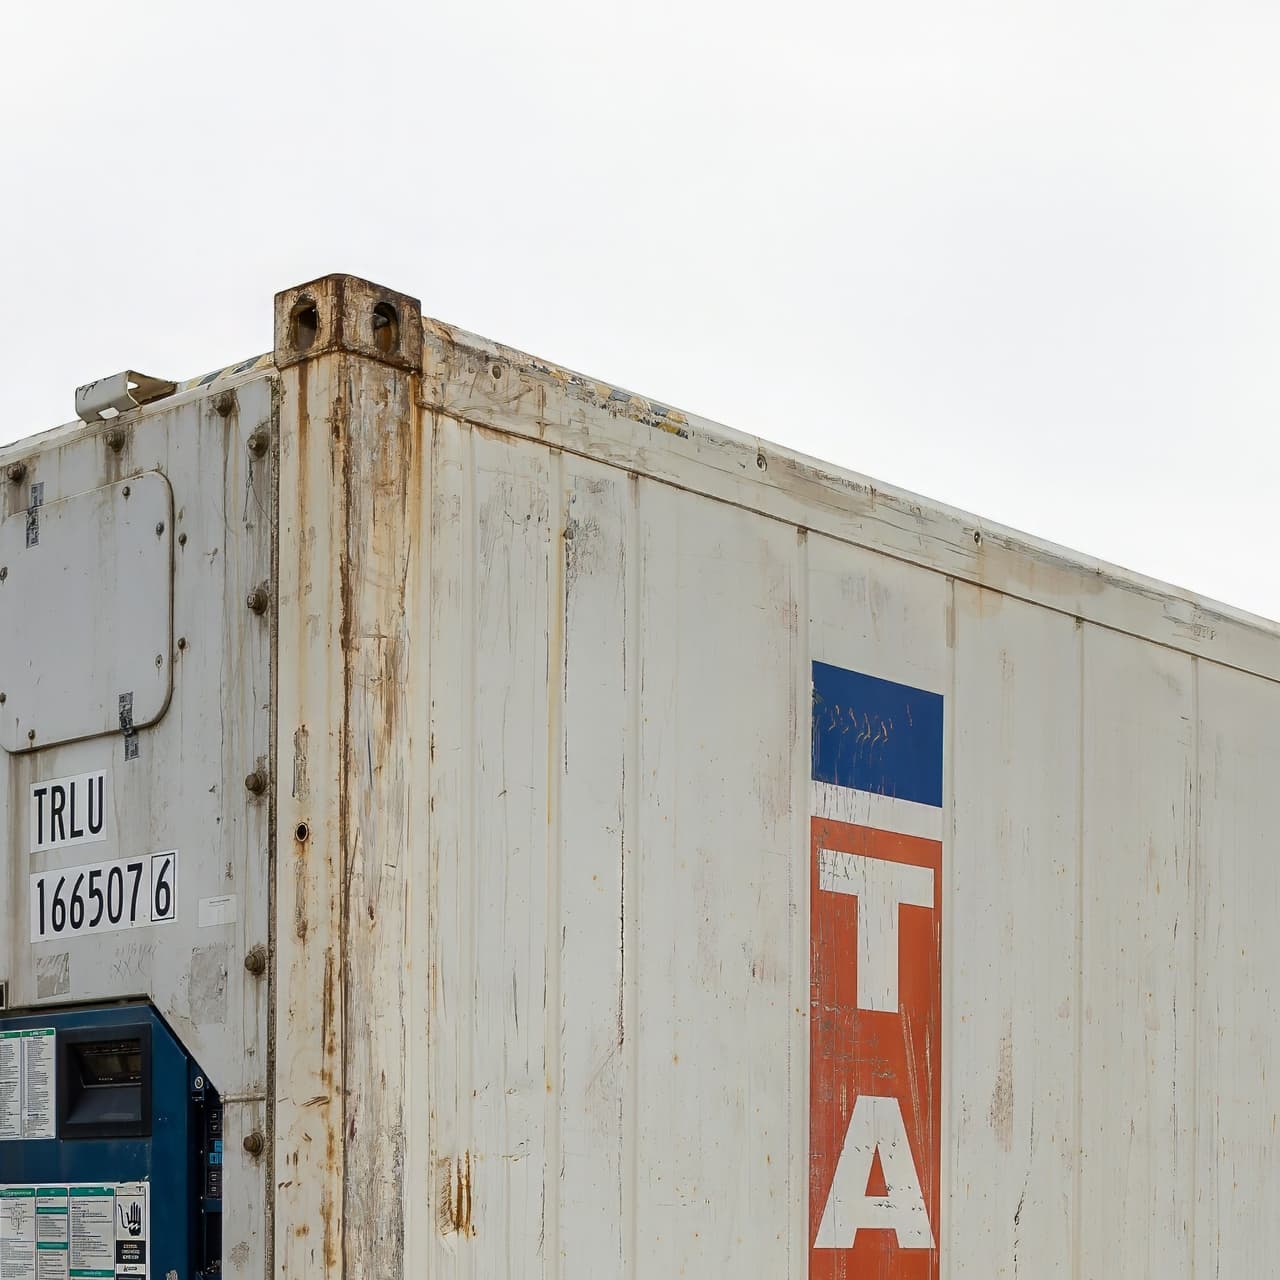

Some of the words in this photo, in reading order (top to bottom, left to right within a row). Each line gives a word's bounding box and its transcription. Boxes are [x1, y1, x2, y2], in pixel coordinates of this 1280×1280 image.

[33, 775, 104, 845] TRLU
[36, 862, 143, 935] 166507
[154, 857, 171, 917] 6
